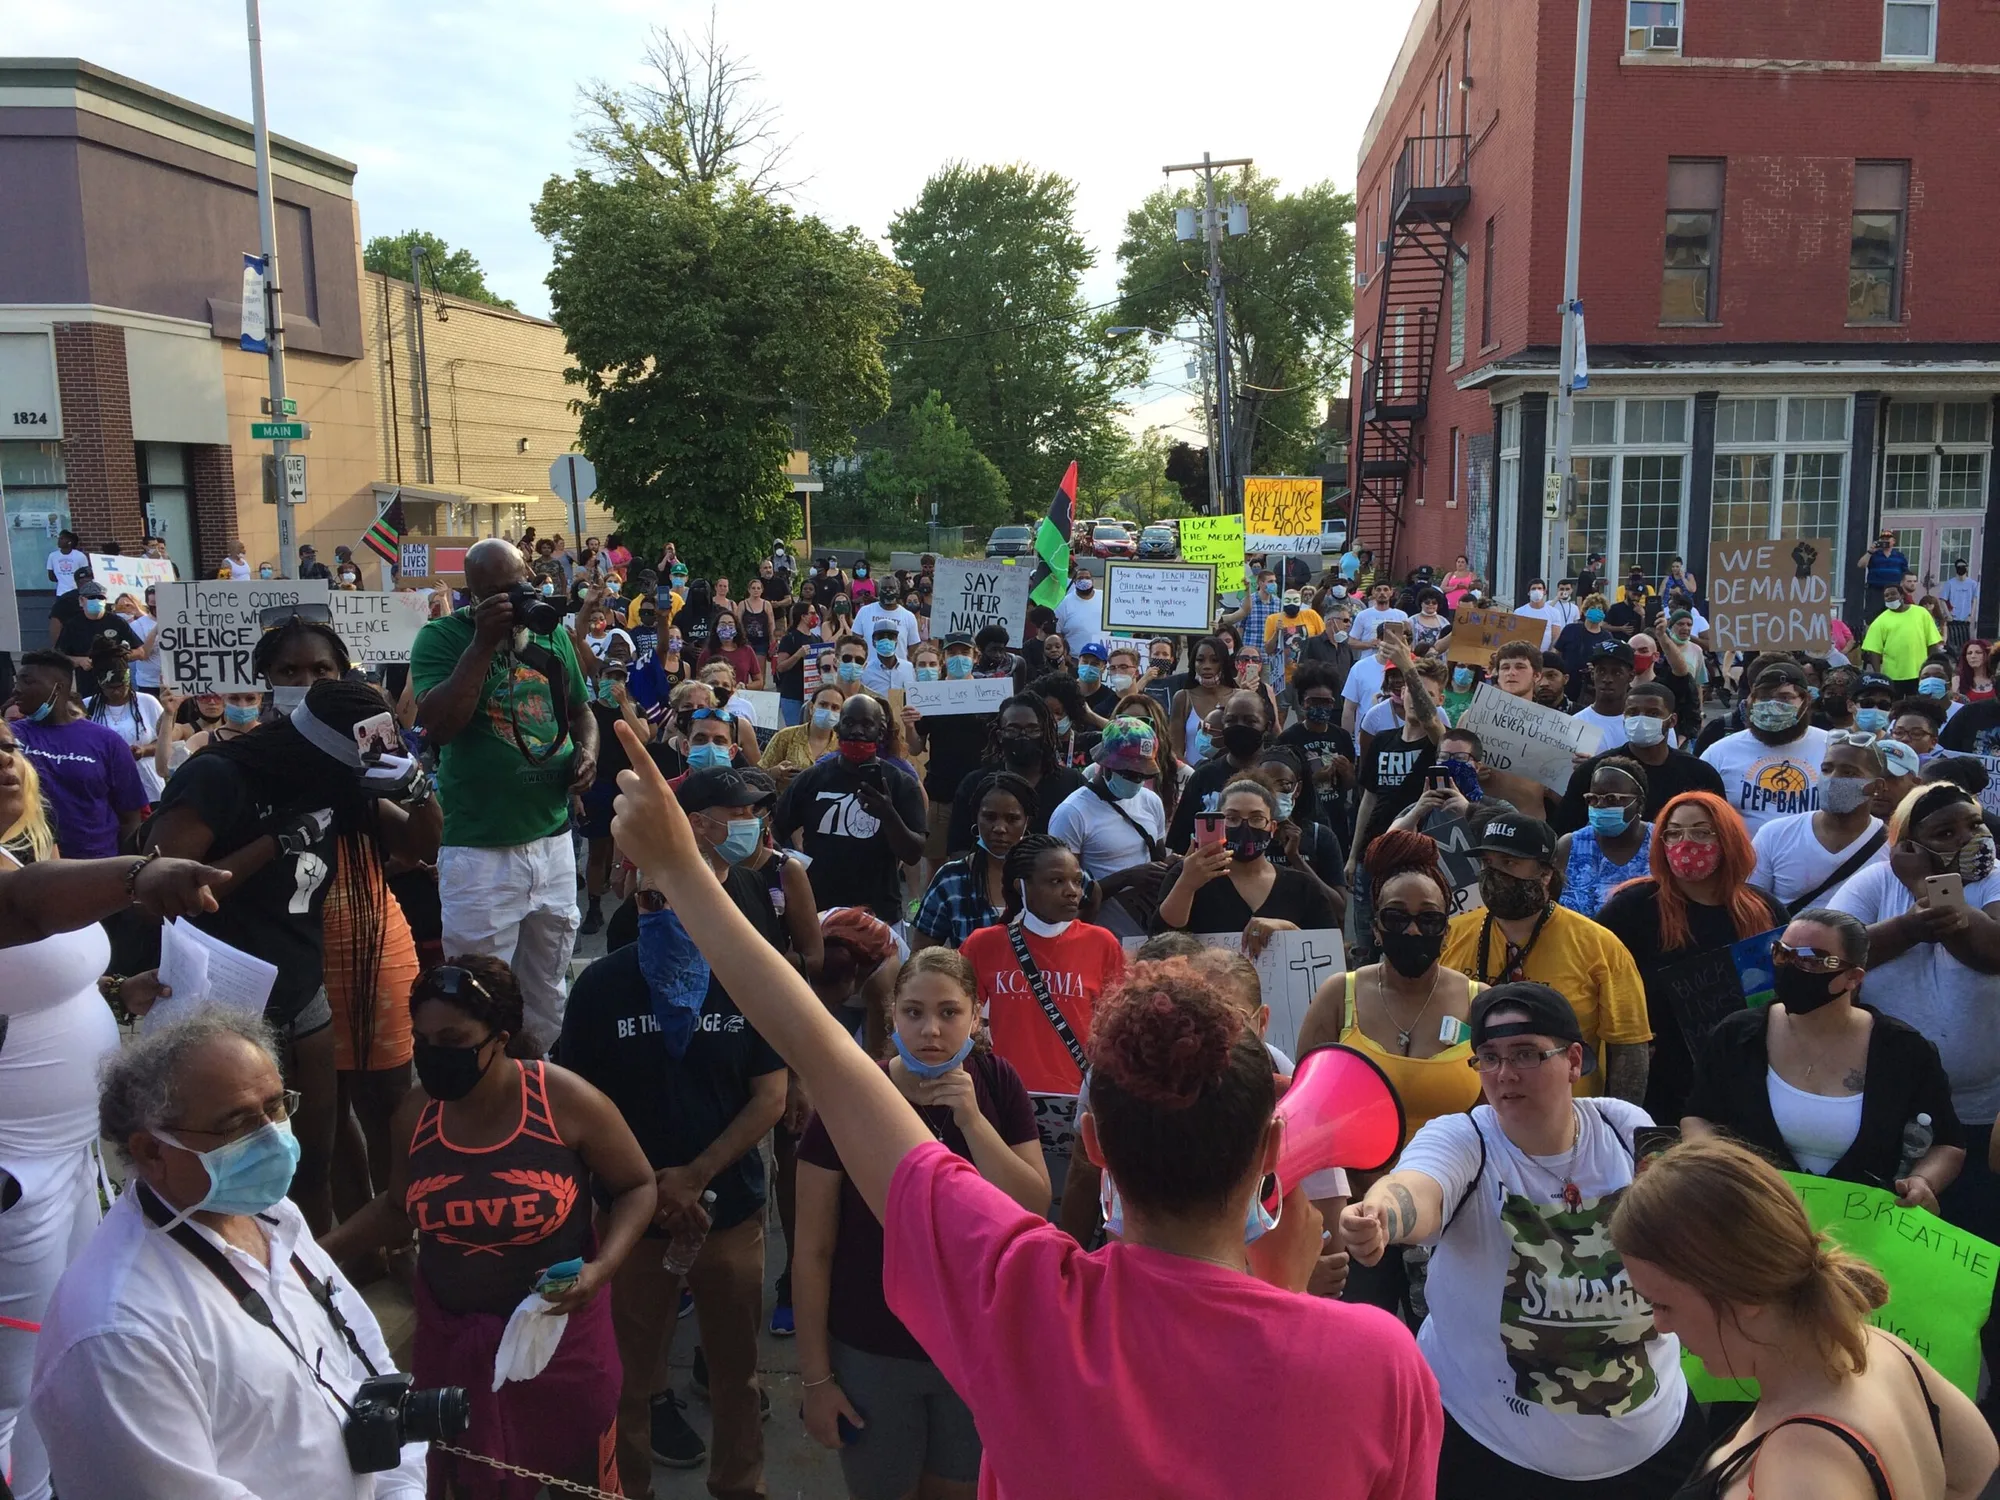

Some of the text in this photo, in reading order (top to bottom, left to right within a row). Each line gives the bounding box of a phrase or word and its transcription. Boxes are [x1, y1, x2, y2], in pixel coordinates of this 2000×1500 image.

[13, 412, 47, 425] 1824
[263, 426, 291, 436] MAIN
[287, 459, 302, 471] ONE
[288, 473, 302, 485] WAY
[1245, 479, 1318, 492] America
[1547, 477, 1560, 489] ONE
[1249, 491, 1315, 508] KKKILLING
[1547, 490, 1560, 500] WAY
[1250, 505, 1313, 522] BLACKS
[1183, 519, 1218, 530] FUCK
[1253, 523, 1266, 534] for
[1274, 520, 1305, 536] 400
[1183, 533, 1241, 541] THE MEDIA
[1248, 537, 1320, 553] since 1619
[403, 544, 427, 555] BLACK
[1183, 545, 1207, 553] STOP
[101, 557, 119, 571] I
[403, 555, 427, 568] LIVES
[1720, 546, 1775, 572] WE
[403, 569, 427, 577] MATTER
[1116, 569, 1131, 581] You
[964, 572, 999, 593] SAY
[1714, 575, 1828, 605] DEMAND
[172, 581, 300, 612] There comes
[328, 593, 392, 615] HITE
[960, 592, 1001, 614] THEIR
[177, 610, 192, 625] a
[195, 609, 235, 631] time
[1125, 608, 1175, 619] against them
[334, 619, 390, 635] ILENCE
[1715, 608, 1829, 649] REFORM
[159, 628, 255, 651] SILENCE
[349, 635, 372, 648] IS
[357, 649, 411, 661] VIOLENC
[1474, 684, 1585, 743] I Understand that I
[1491, 713, 1525, 736] NEVER
[1527, 725, 1578, 754] Understand
[1520, 743, 1527, 758] I
[1740, 780, 1772, 811] PEP
[1483, 822, 1517, 839] Bills
[617, 1017, 636, 1039] BE
[416, 1193, 545, 1231] LOVE
[1843, 1190, 1990, 1280] BREATHE
